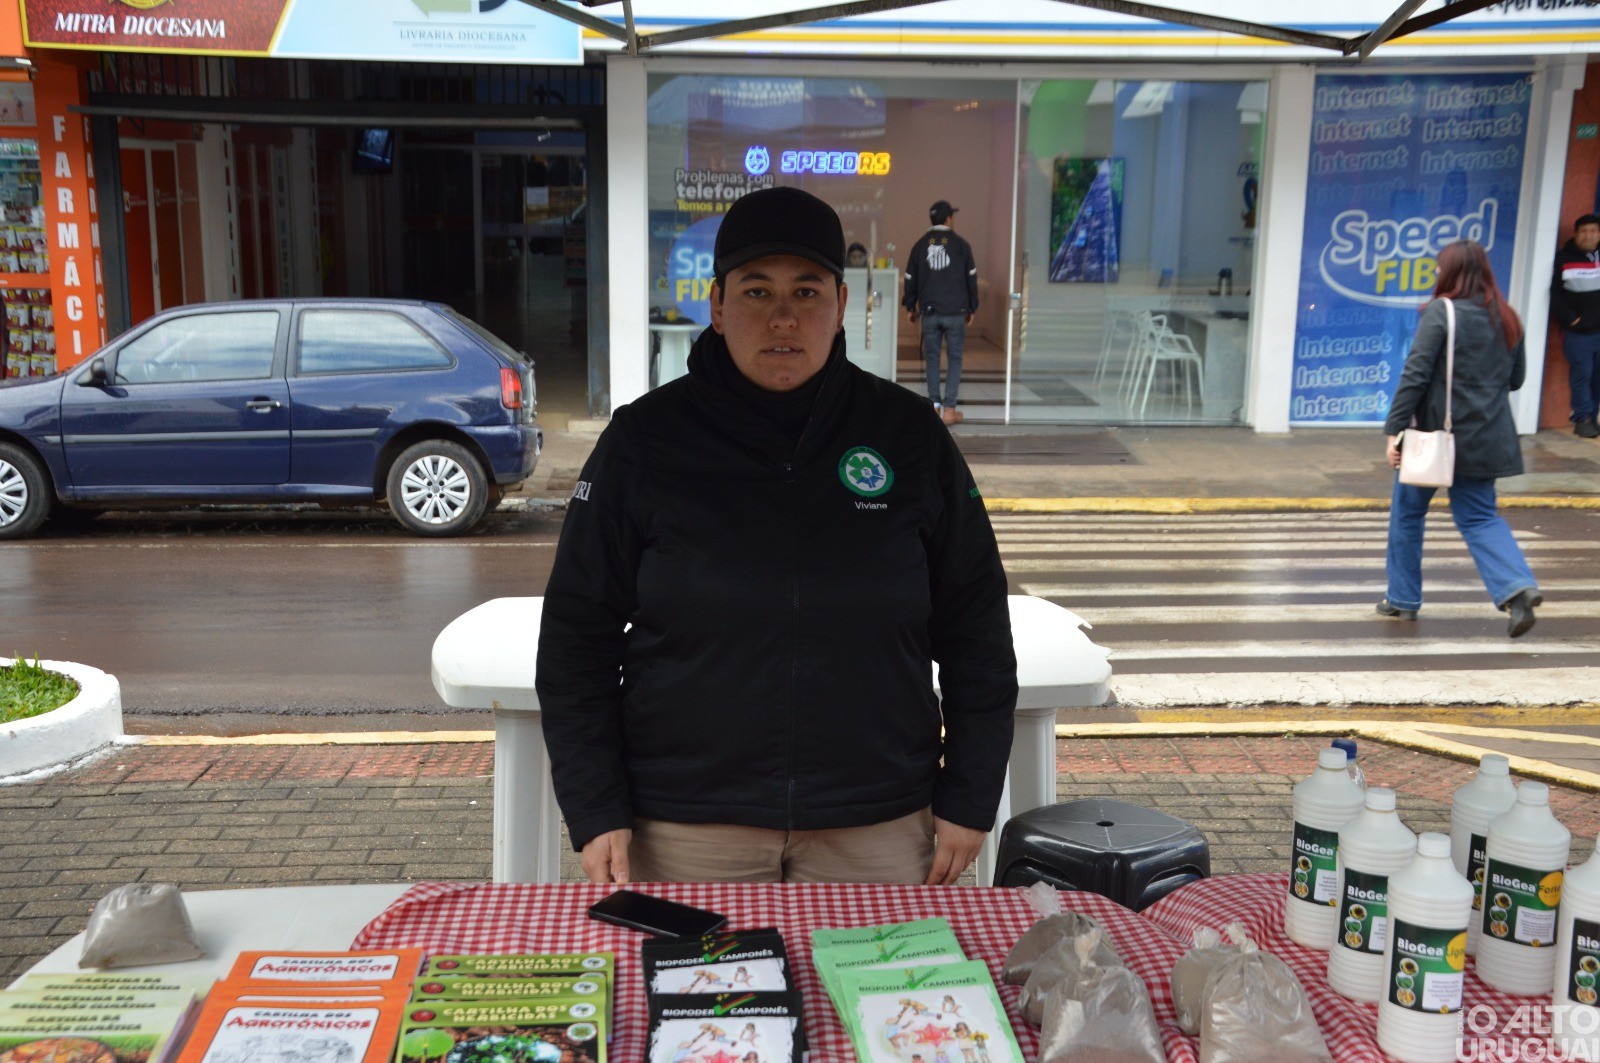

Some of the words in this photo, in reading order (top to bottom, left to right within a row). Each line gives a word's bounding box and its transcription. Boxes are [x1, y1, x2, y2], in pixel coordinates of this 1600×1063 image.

[55, 12, 116, 34] MITRA
[123, 15, 226, 38] DIOCESANA
[400, 30, 454, 41] LIVRARIA
[458, 31, 527, 43] DIOCESANA
[1316, 80, 1415, 112] Internet
[1425, 79, 1528, 112] Internet
[1314, 113, 1412, 144] Internet
[1422, 112, 1523, 144] Internet
[1312, 144, 1409, 174] Internet
[1419, 144, 1520, 174] Internet
[675, 169, 744, 184] Problemas
[747, 173, 774, 184] com
[676, 199, 713, 211] Temos
[716, 202, 723, 211] a
[84, 117, 106, 346] FARMÁCI
[1330, 198, 1498, 275] Speed
[53, 115, 83, 368] FARMÁCI
[676, 247, 714, 279] Sp
[1375, 258, 1438, 294] FIB
[676, 278, 716, 302] FIX
[1298, 331, 1393, 359] Internet
[1296, 360, 1391, 389] Internet
[1294, 390, 1388, 418] Internet
[854, 502, 888, 510] Viviane
[1296, 838, 1334, 856] BioGea
[1474, 849, 1486, 860] Bi
[1492, 873, 1536, 893] BioGea
[831, 937, 877, 945] BIOPODER
[1397, 937, 1444, 957] BioGea
[1577, 934, 1600, 950] Bio
[655, 957, 706, 967] BIOPODER
[718, 949, 774, 962] CAMPONÊS
[835, 958, 882, 968] BIOPODER
[895, 947, 947, 960] CAMPONÊS
[258, 963, 393, 974] AGROTÓXICOS
[475, 963, 570, 971] HERBICIDAS
[462, 988, 561, 996] HERBICIDAS
[858, 984, 907, 992] BIOPODER
[923, 976, 978, 988] CAMPONÊS
[26, 1015, 98, 1023] CARTILHA
[443, 1007, 531, 1015] CARTILHA
[535, 1005, 567, 1013] DOS
[453, 1013, 557, 1022] HERBICIDAS
[662, 1008, 715, 1017] BIOPODER
[730, 1006, 789, 1015] CAMPONÊS
[74, 1023, 142, 1032] CLIMÁTICA
[226, 1016, 372, 1030] AGROTÓXICOS
